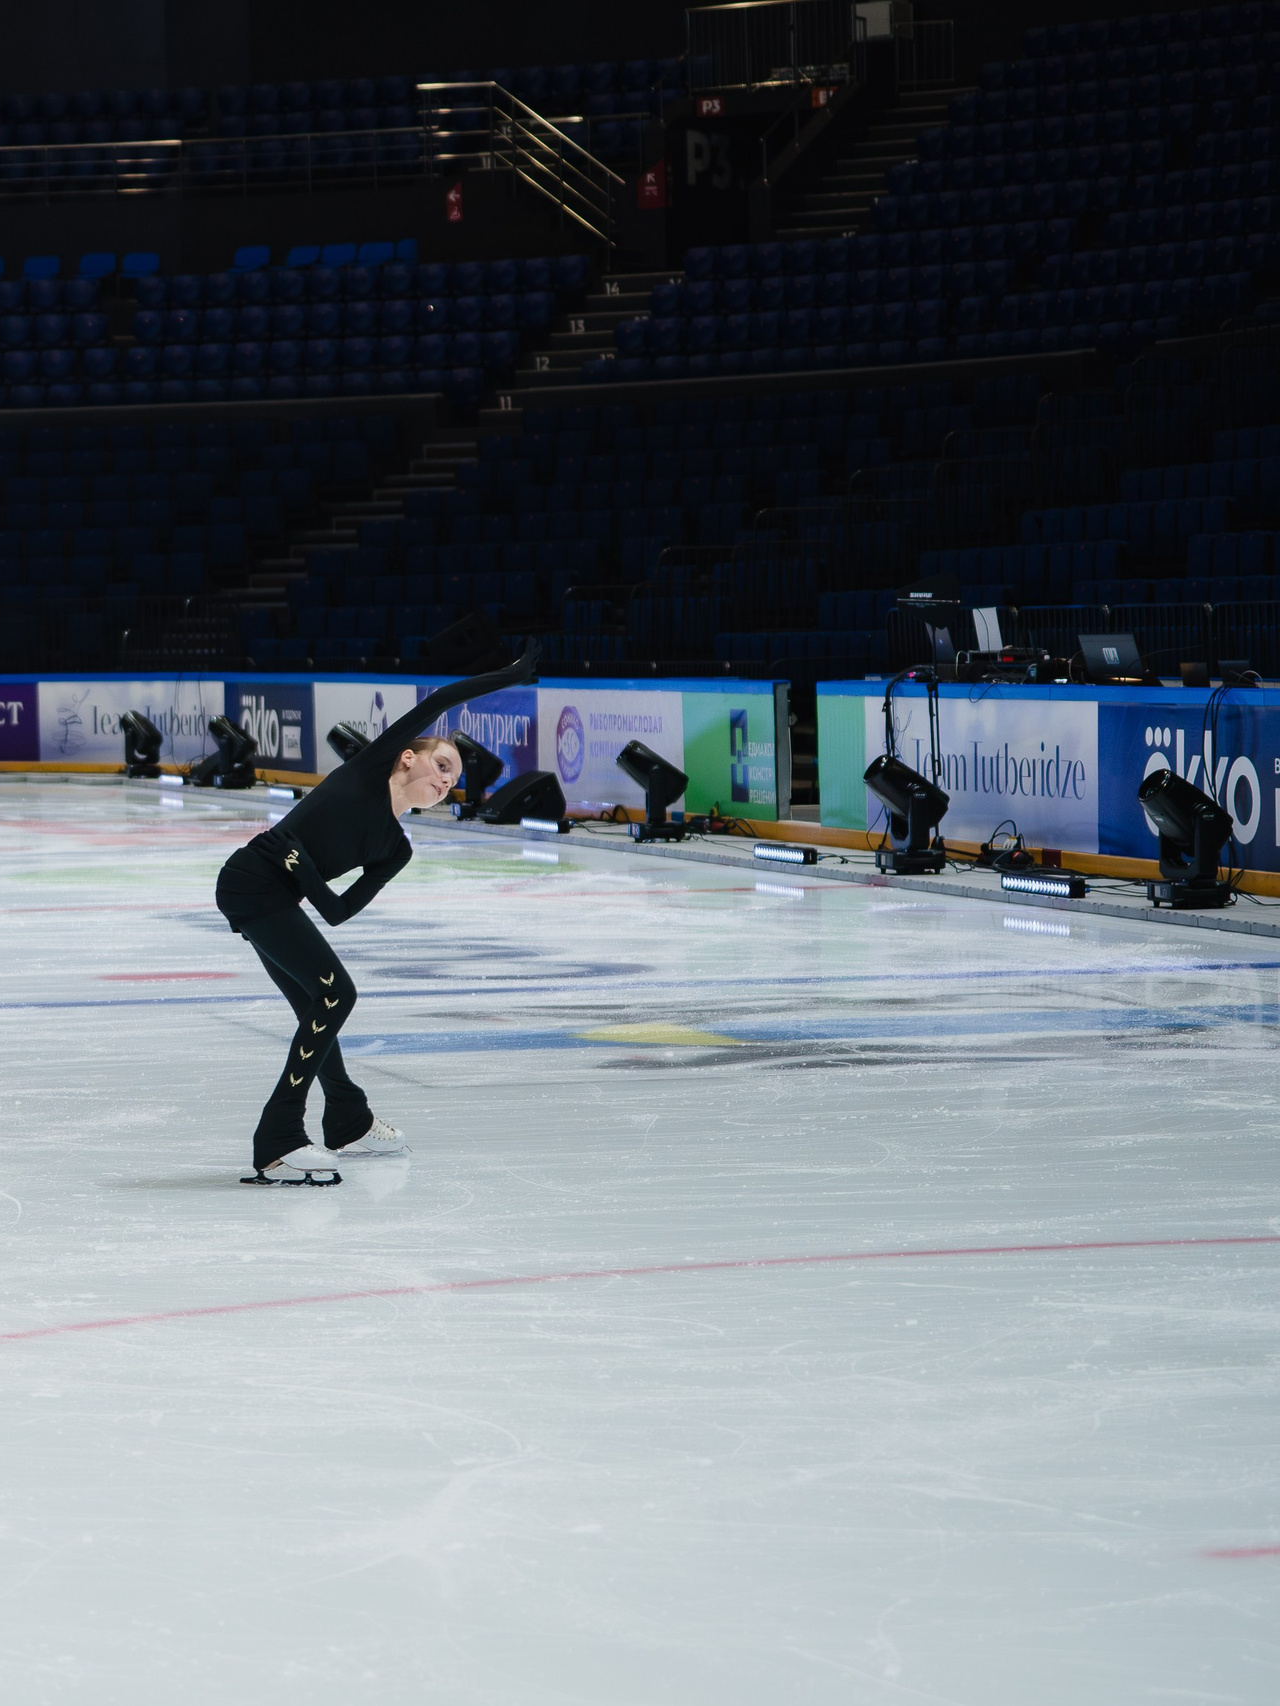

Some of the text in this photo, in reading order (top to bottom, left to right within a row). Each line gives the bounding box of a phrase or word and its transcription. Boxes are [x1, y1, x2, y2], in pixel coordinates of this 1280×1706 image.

[499, 396, 512, 410] 11
[460, 703, 531, 757] Фигурист
[589, 713, 663, 733] РЫБОПРОМЫСЛОВАЯ
[969, 740, 1087, 800] Tutberidze
